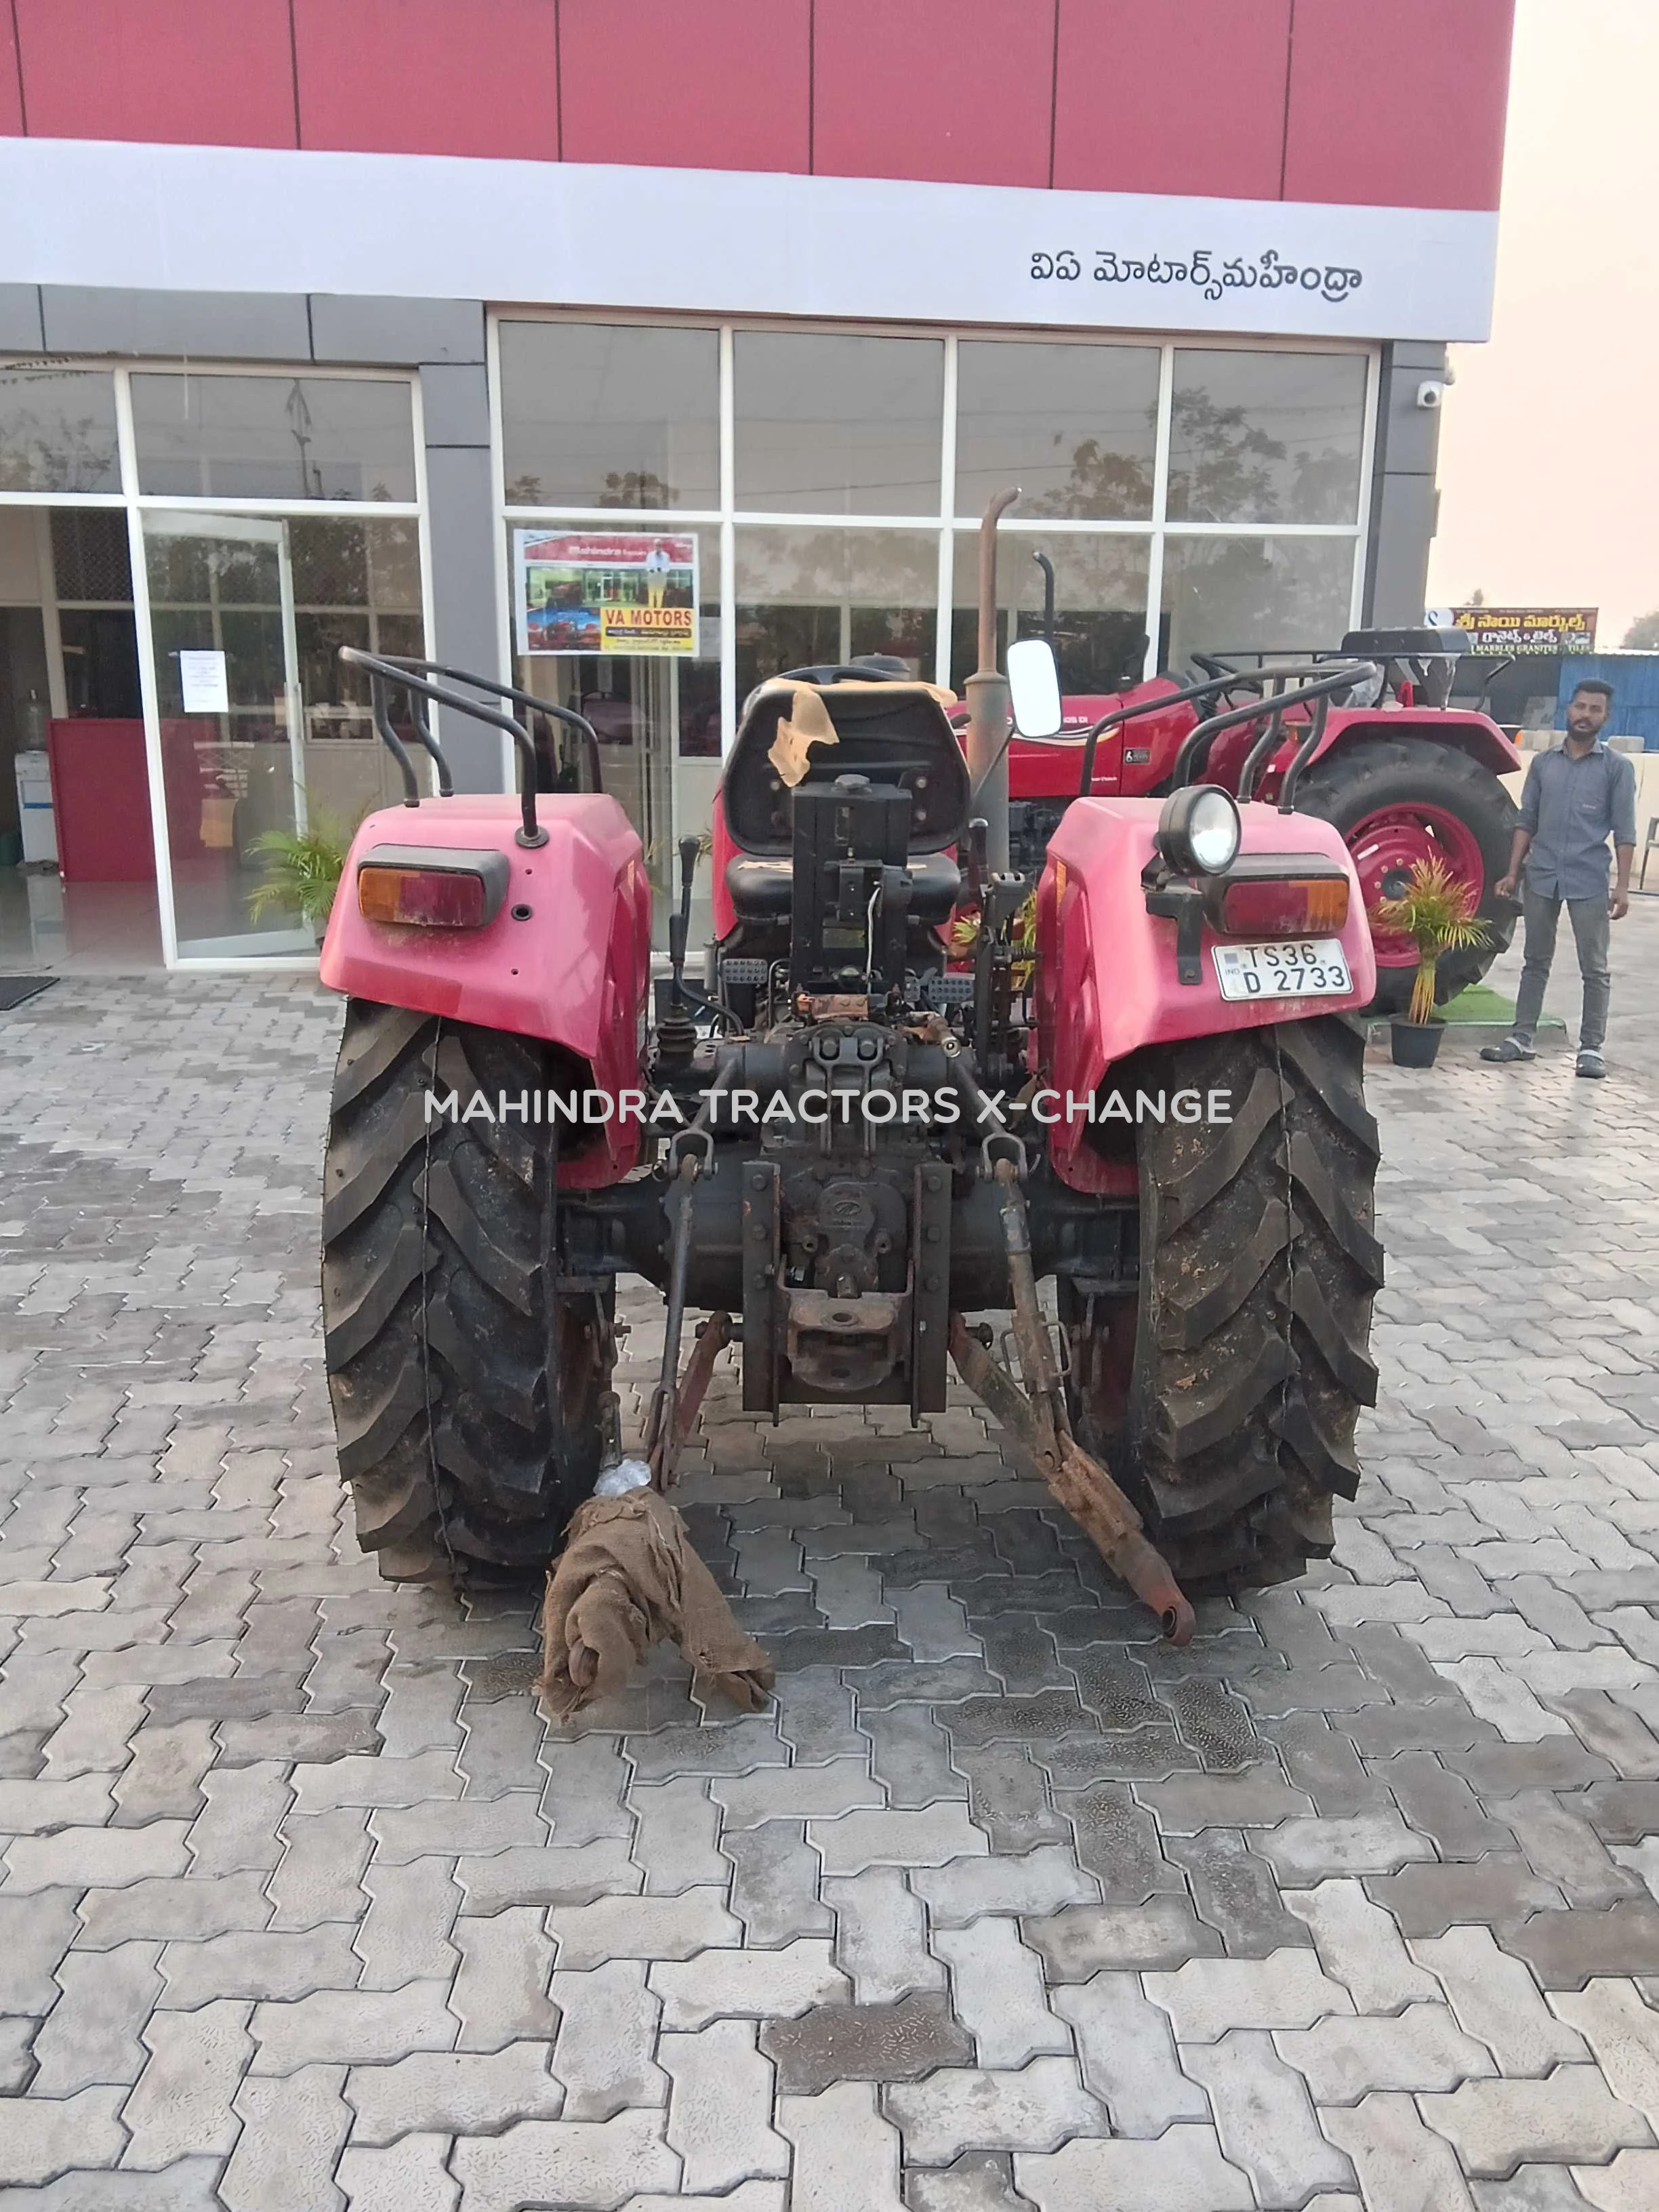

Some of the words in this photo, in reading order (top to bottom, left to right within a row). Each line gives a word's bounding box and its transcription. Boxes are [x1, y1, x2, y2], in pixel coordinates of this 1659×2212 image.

[605, 609, 625, 624] VA
[630, 610, 692, 626] MOTORS
[1244, 943, 1317, 968] TS36
[1225, 968, 1240, 976] IND
[1244, 971, 1261, 994] D
[1273, 966, 1345, 991] 2733
